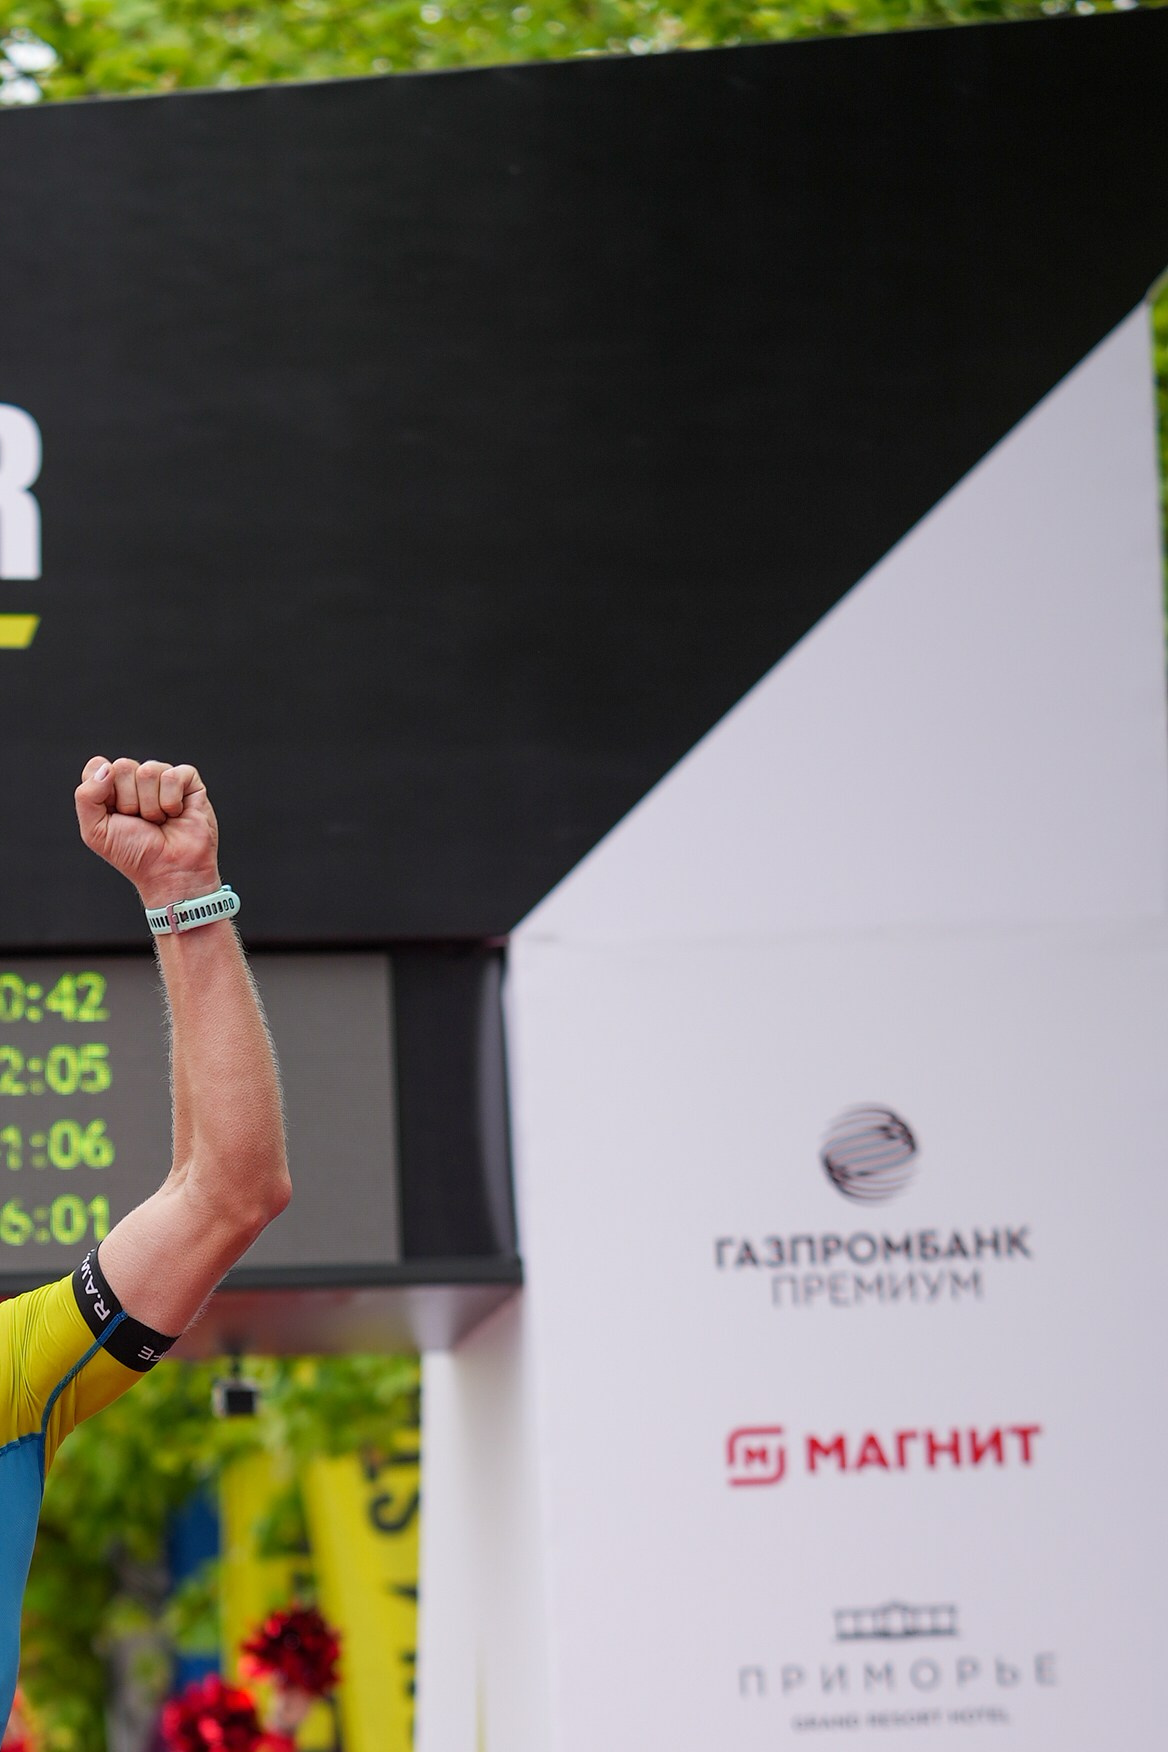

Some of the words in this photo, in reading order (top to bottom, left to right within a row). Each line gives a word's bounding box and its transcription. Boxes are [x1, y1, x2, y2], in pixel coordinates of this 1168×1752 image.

[715, 1227, 1035, 1270] ГАЗПРОМБАНК
[771, 1270, 984, 1307] ПРЕМИУМ
[805, 1425, 1042, 1474] МАГНИТ
[737, 1652, 1062, 1700] ПРИМОРЬЕ
